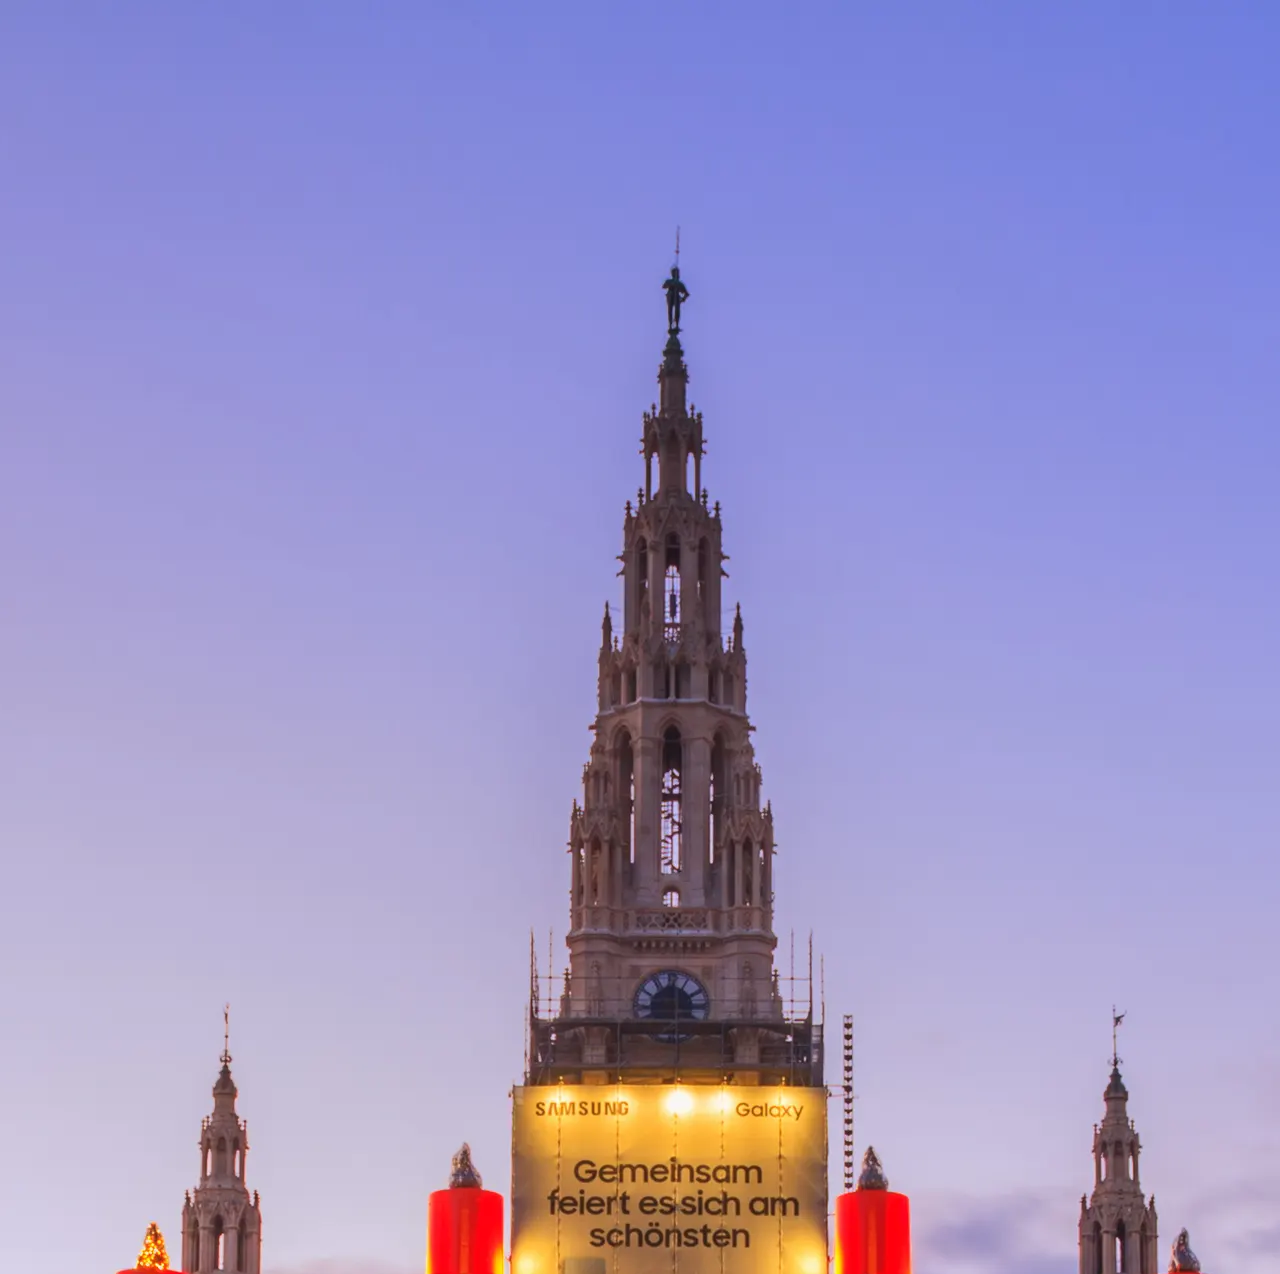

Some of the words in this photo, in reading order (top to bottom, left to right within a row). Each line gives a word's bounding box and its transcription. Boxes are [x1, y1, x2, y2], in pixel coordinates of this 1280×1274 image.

[535, 1101, 629, 1116] SAMSUNG
[736, 1102, 804, 1119] Galaxy
[573, 1156, 763, 1184] Gemeinsam
[548, 1189, 630, 1216] feiert
[639, 1195, 674, 1216] es
[680, 1189, 740, 1216] sich
[749, 1195, 800, 1216] am
[589, 1222, 751, 1248] schönsten
